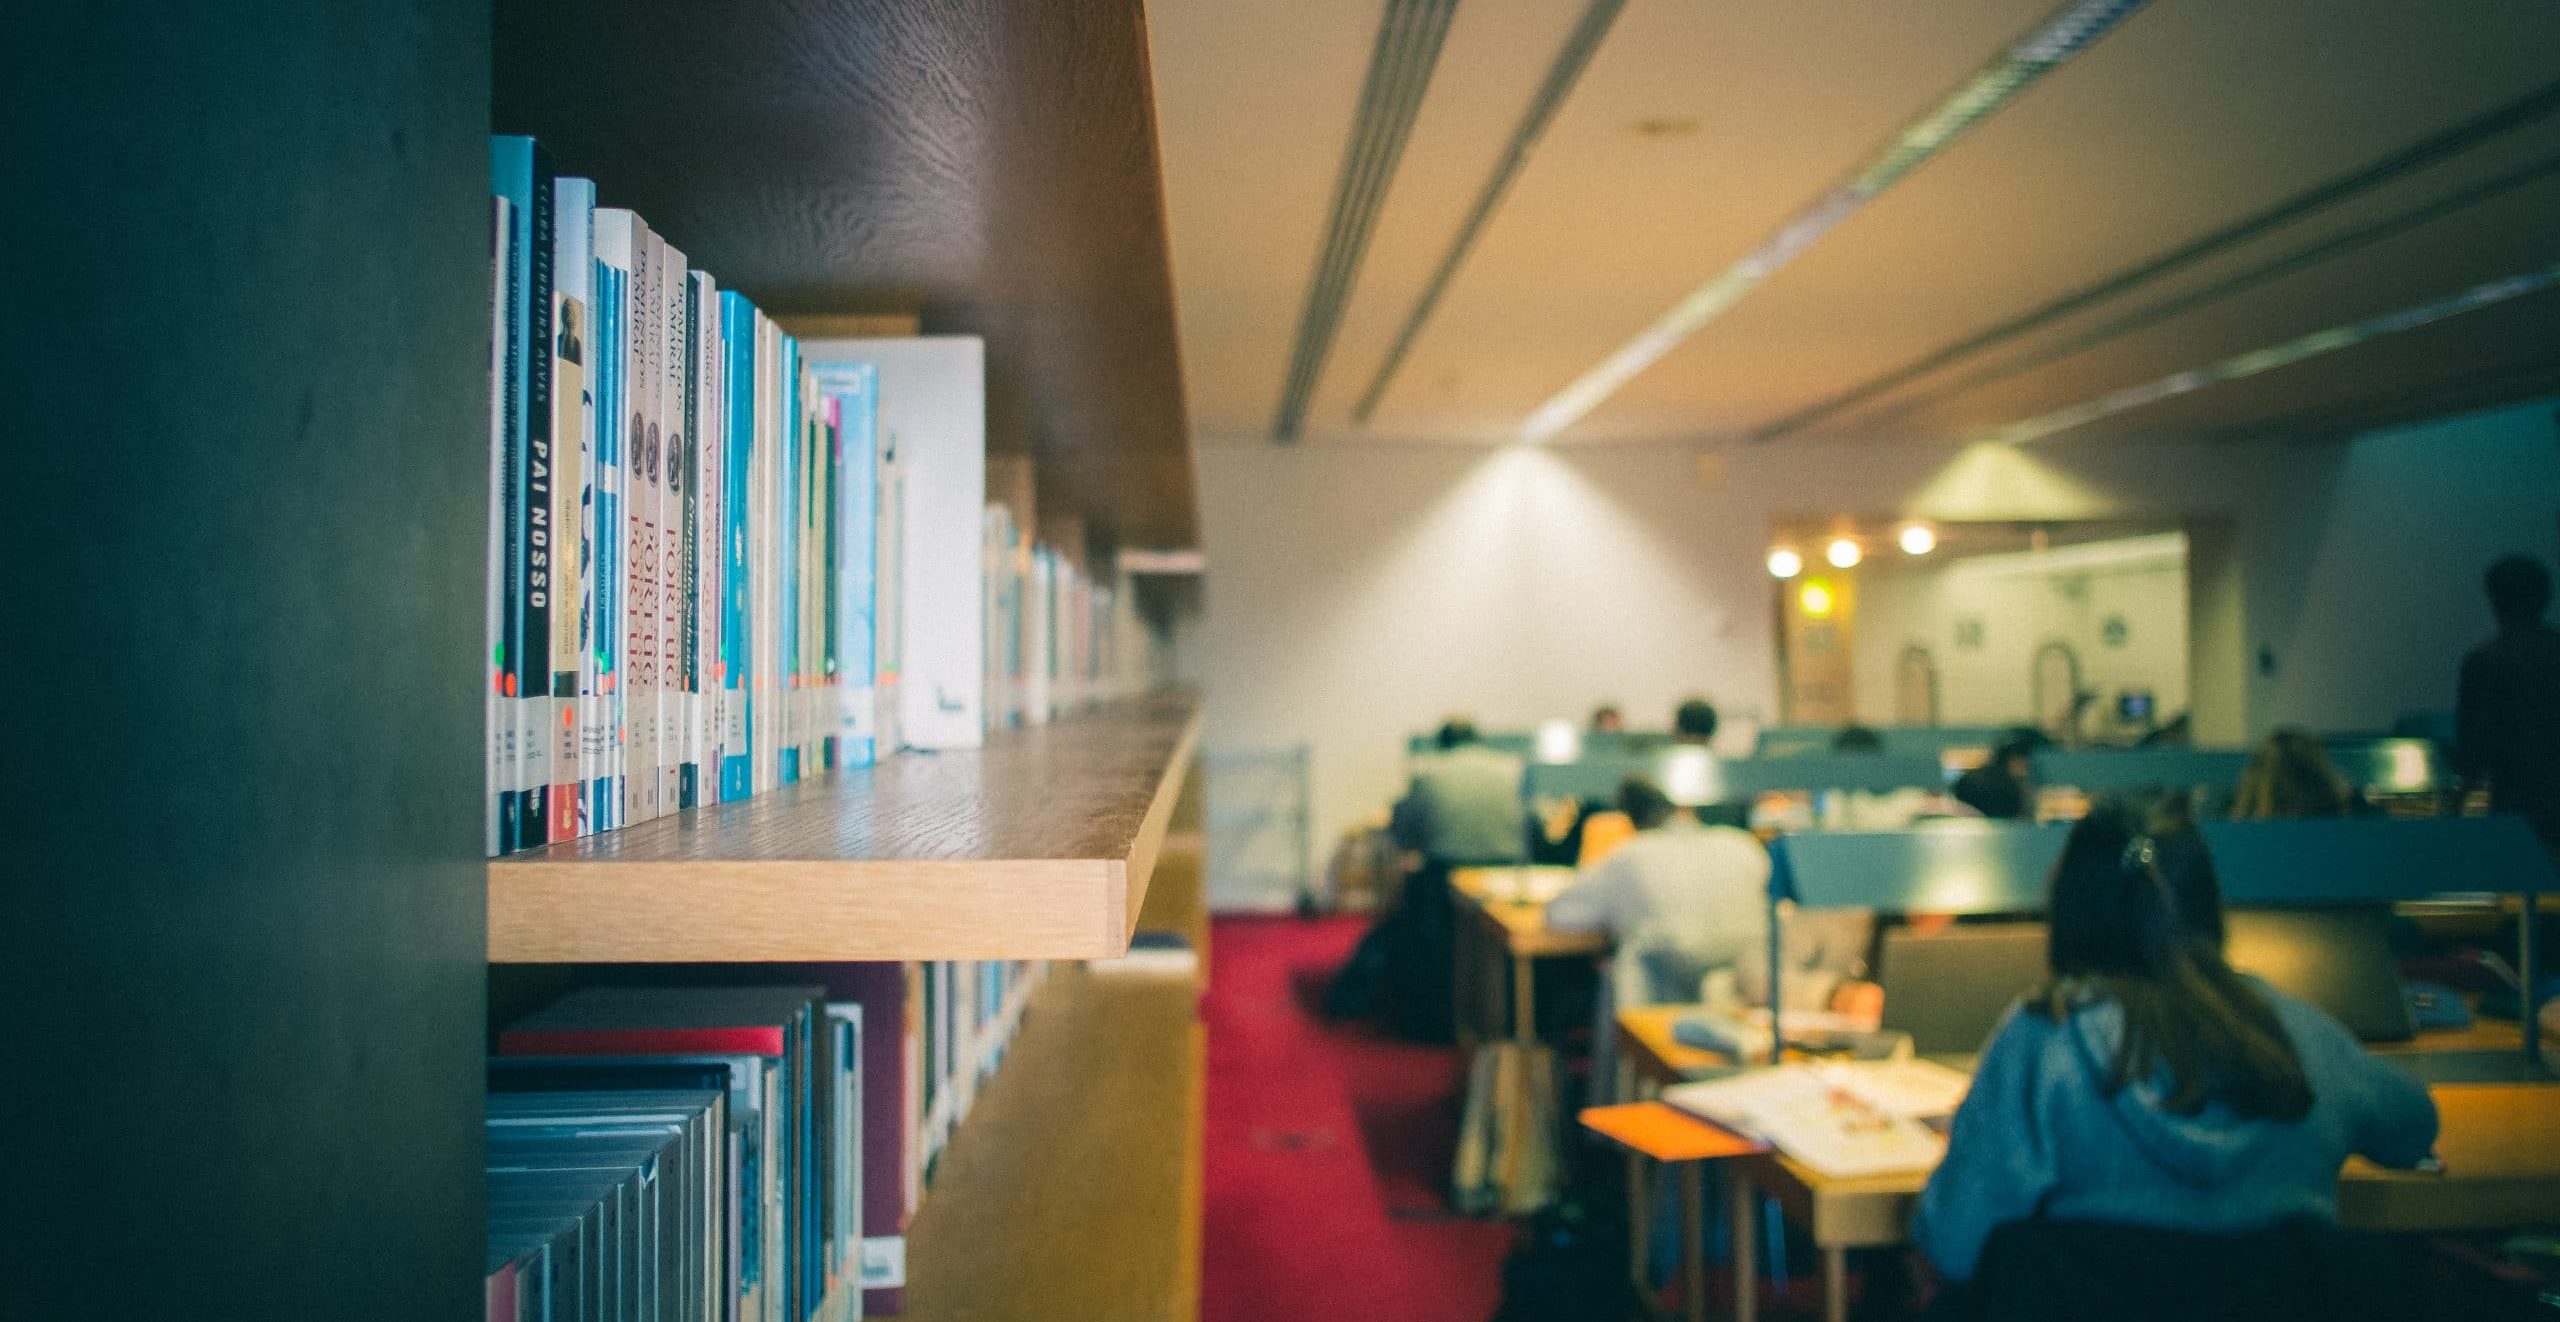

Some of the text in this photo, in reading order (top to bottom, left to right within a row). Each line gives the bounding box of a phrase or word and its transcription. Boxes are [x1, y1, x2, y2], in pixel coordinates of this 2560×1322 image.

[536, 347, 547, 402] ALVES
[669, 296, 677, 388] AMARAL
[530, 439, 548, 608] PAI NOSSO
[629, 514, 640, 686] PORTUG
[687, 495, 695, 594] Enquanto
[643, 521, 655, 687] PORTUG
[665, 528, 676, 688] PORTUG
